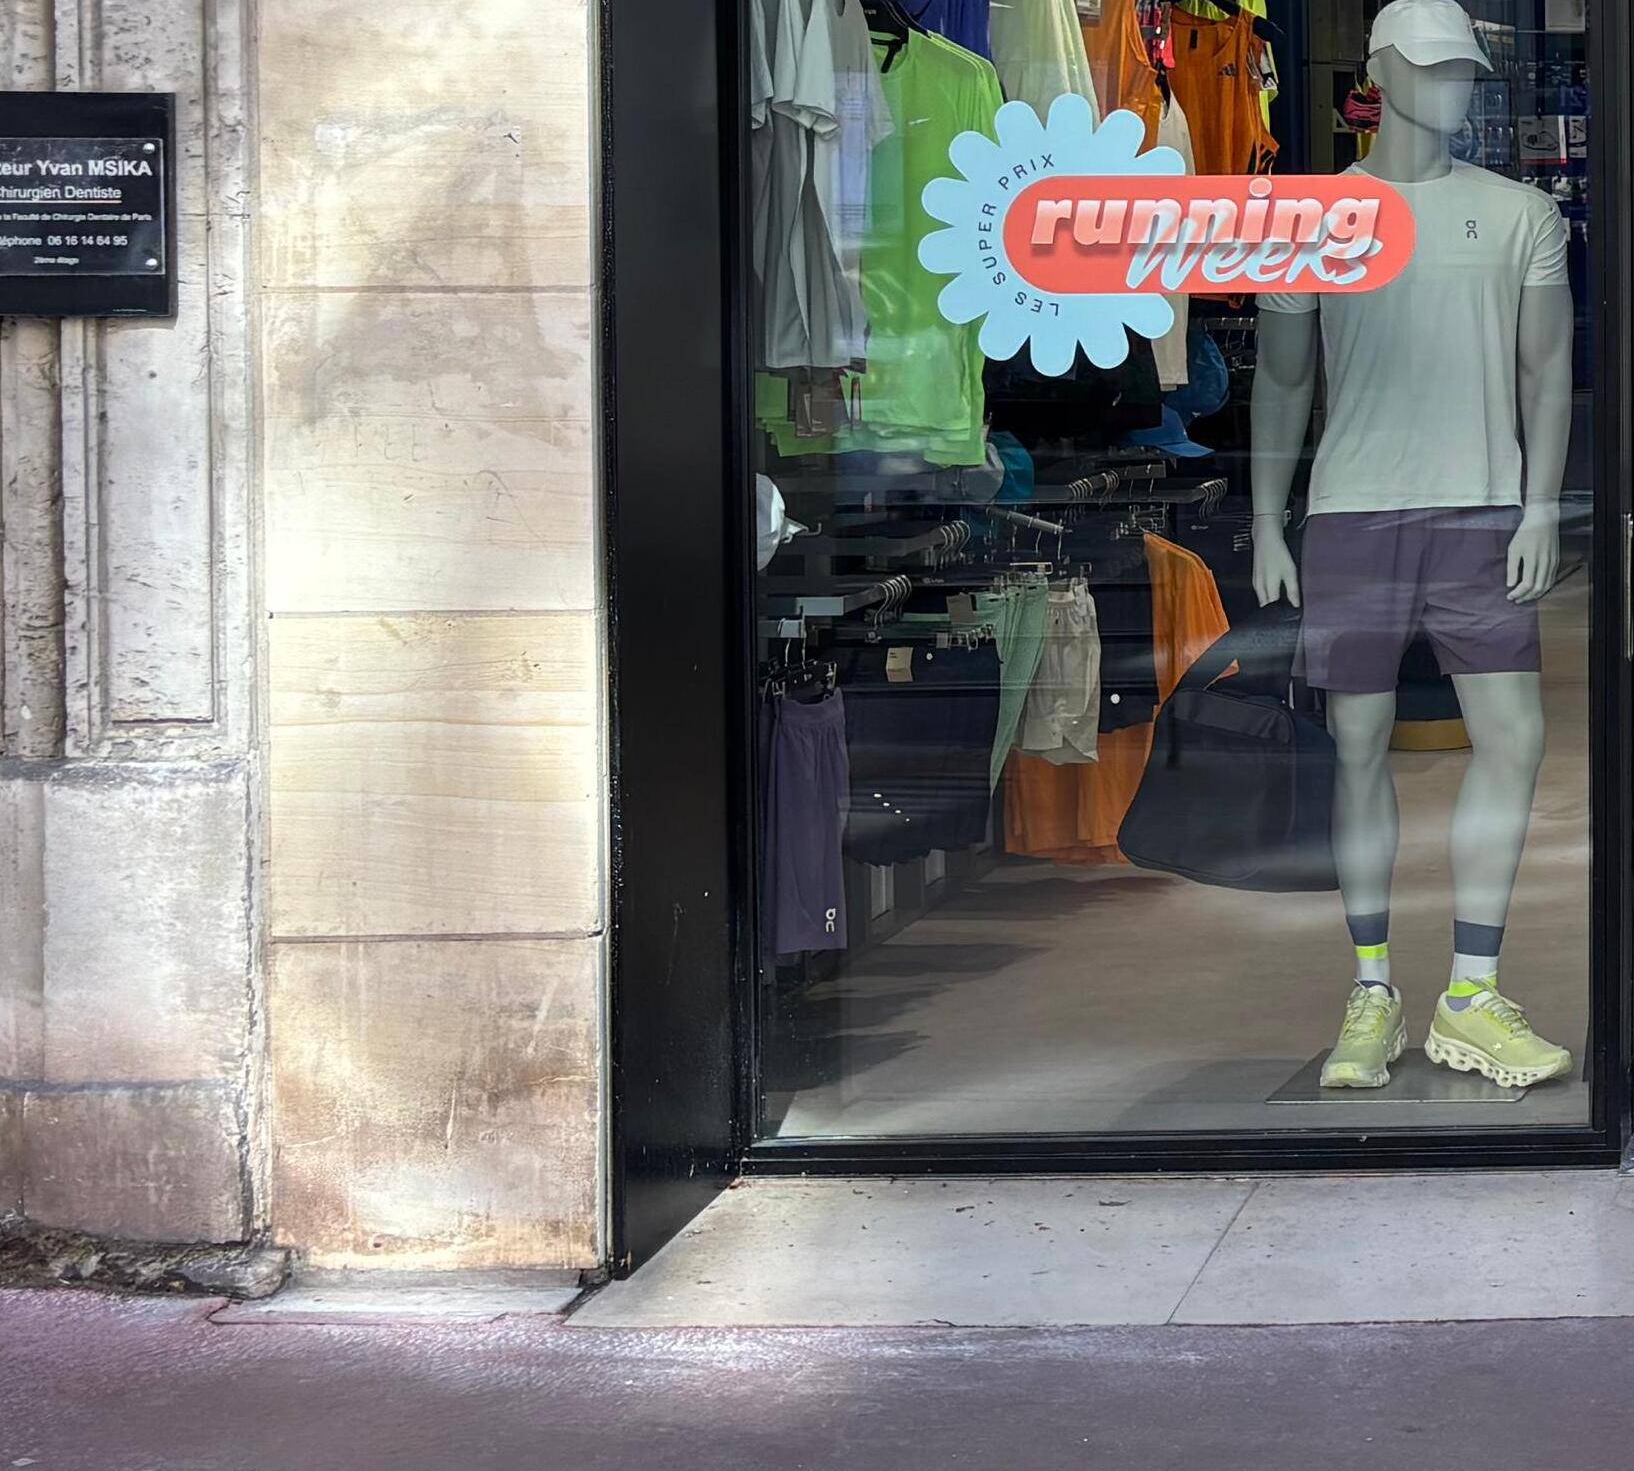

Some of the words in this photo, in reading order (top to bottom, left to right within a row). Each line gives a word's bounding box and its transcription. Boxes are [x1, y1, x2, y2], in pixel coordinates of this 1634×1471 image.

[36, 159, 83, 176] Yvan
[88, 159, 153, 176] MSIKA
[64, 186, 122, 199] Dentiste
[978, 202, 1007, 286] SUPER
[998, 153, 1055, 190] PRIX
[1030, 177, 1380, 260] running
